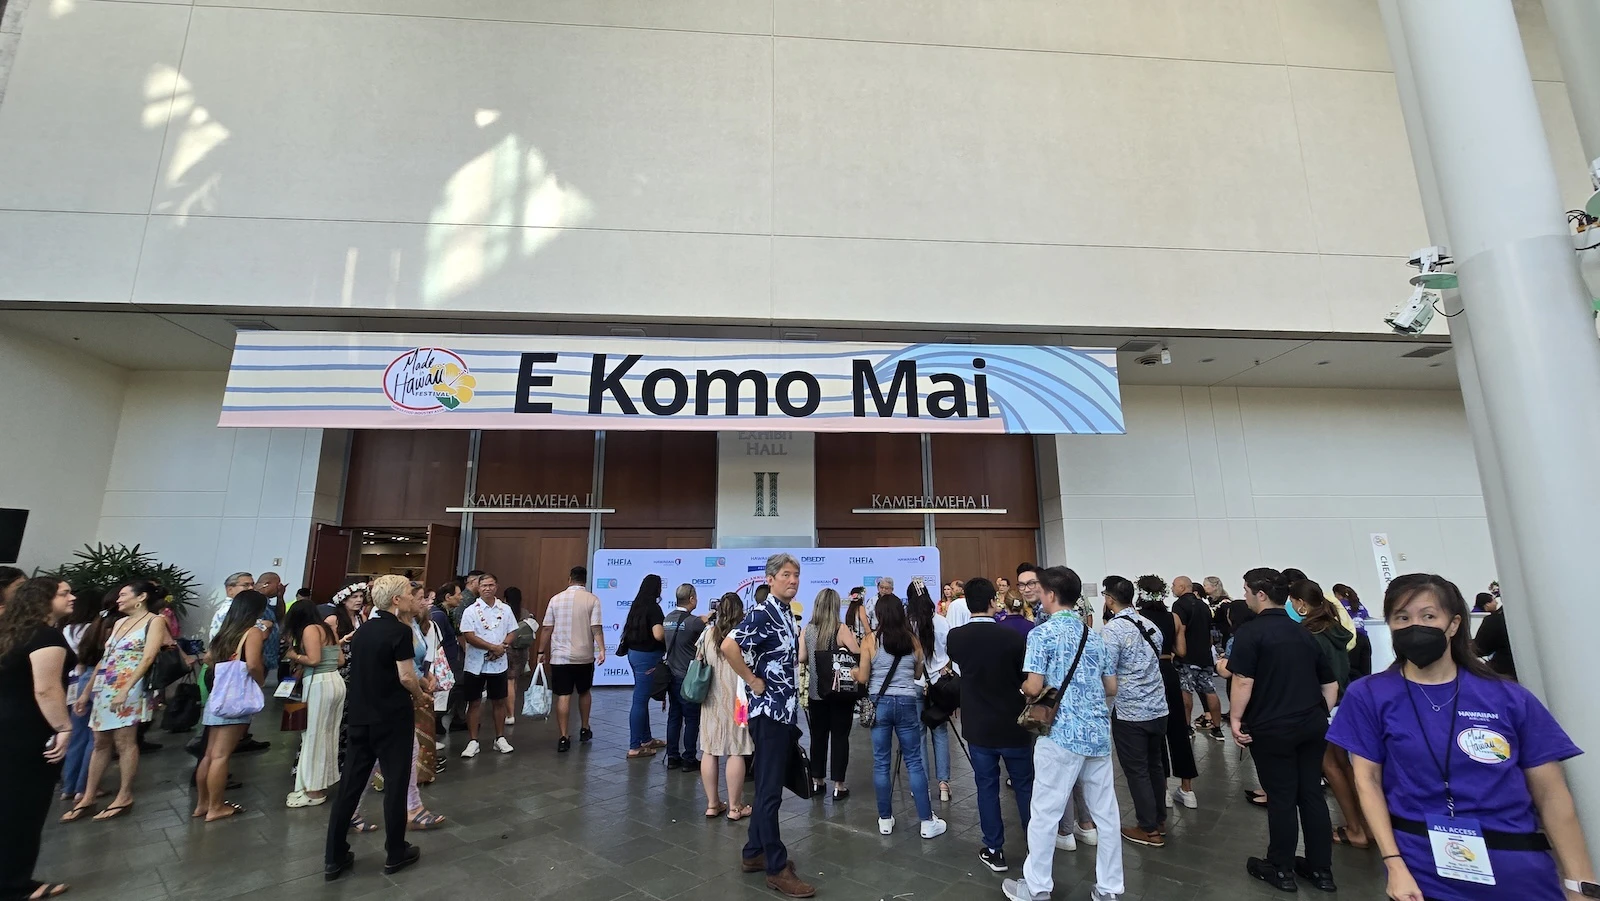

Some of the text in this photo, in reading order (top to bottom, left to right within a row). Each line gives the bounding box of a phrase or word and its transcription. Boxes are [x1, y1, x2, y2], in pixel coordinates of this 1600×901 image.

[403, 348, 435, 374] Made
[514, 353, 990, 418] E Komo Mai
[739, 431, 793, 440] EXHIBIT
[746, 442, 788, 455] HALL
[468, 492, 579, 507] KAMEHAMEHA
[872, 494, 990, 508] KAMEHAMEHA II
[1380, 555, 1392, 583] CHECK
[833, 653, 856, 664] KARL
[1457, 711, 1499, 719] HAWAIIAN
[1467, 729, 1485, 742] Made
[1449, 827, 1477, 836] ACCESS
